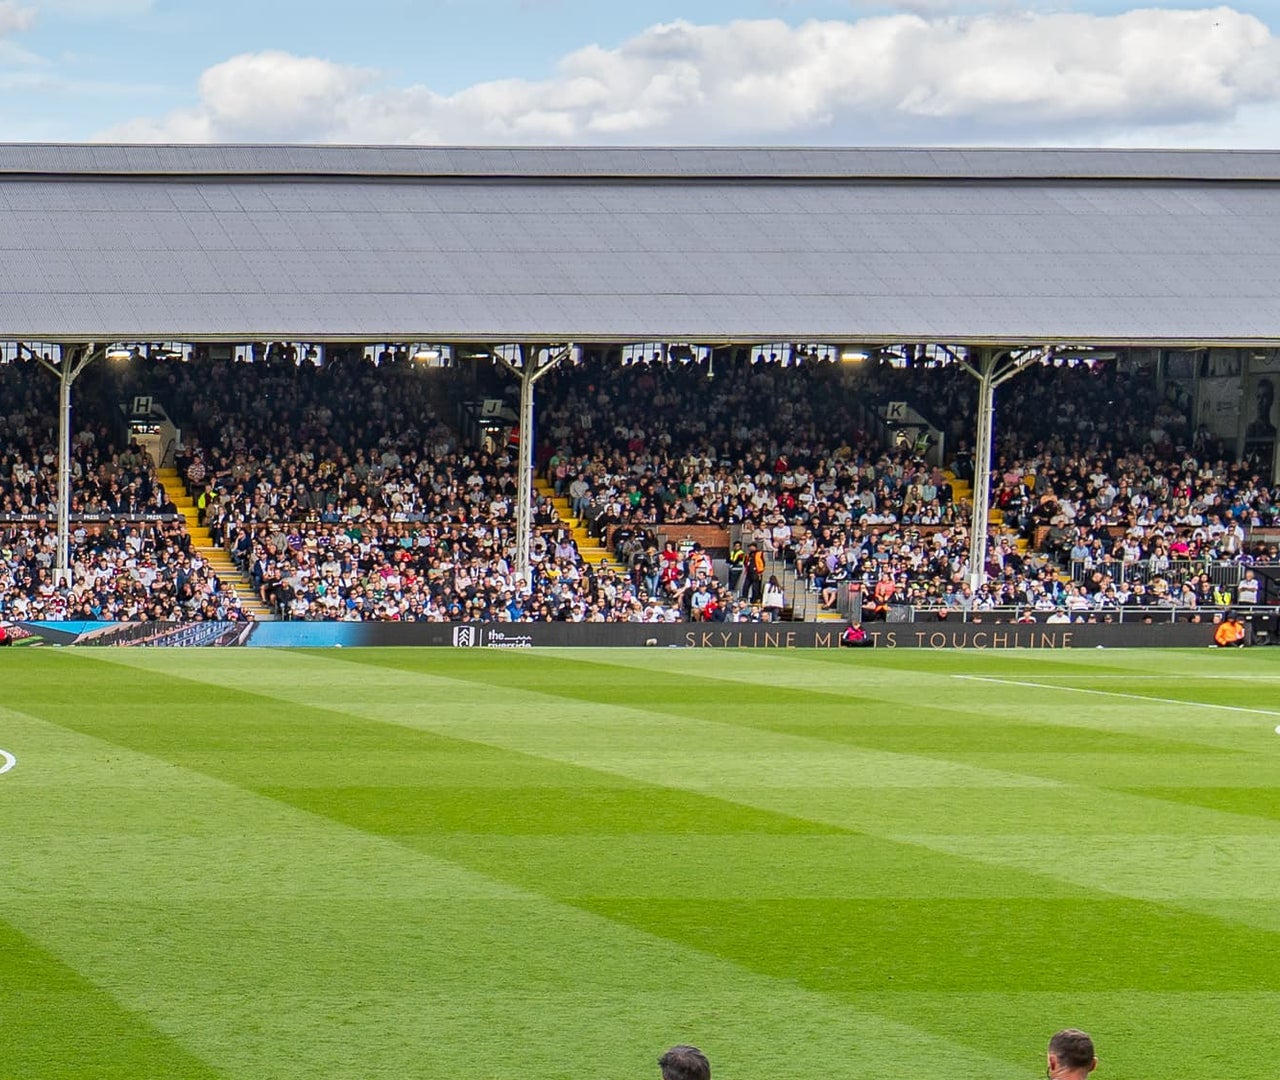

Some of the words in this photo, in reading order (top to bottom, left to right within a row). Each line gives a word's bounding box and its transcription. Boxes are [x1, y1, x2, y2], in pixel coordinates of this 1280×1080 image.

[136, 398, 149, 411] H
[487, 401, 497, 413] J
[890, 404, 902, 416] K
[488, 629, 505, 640] the
[685, 632, 797, 648] SKYLINE
[915, 632, 1074, 648] TOUCHLINE
